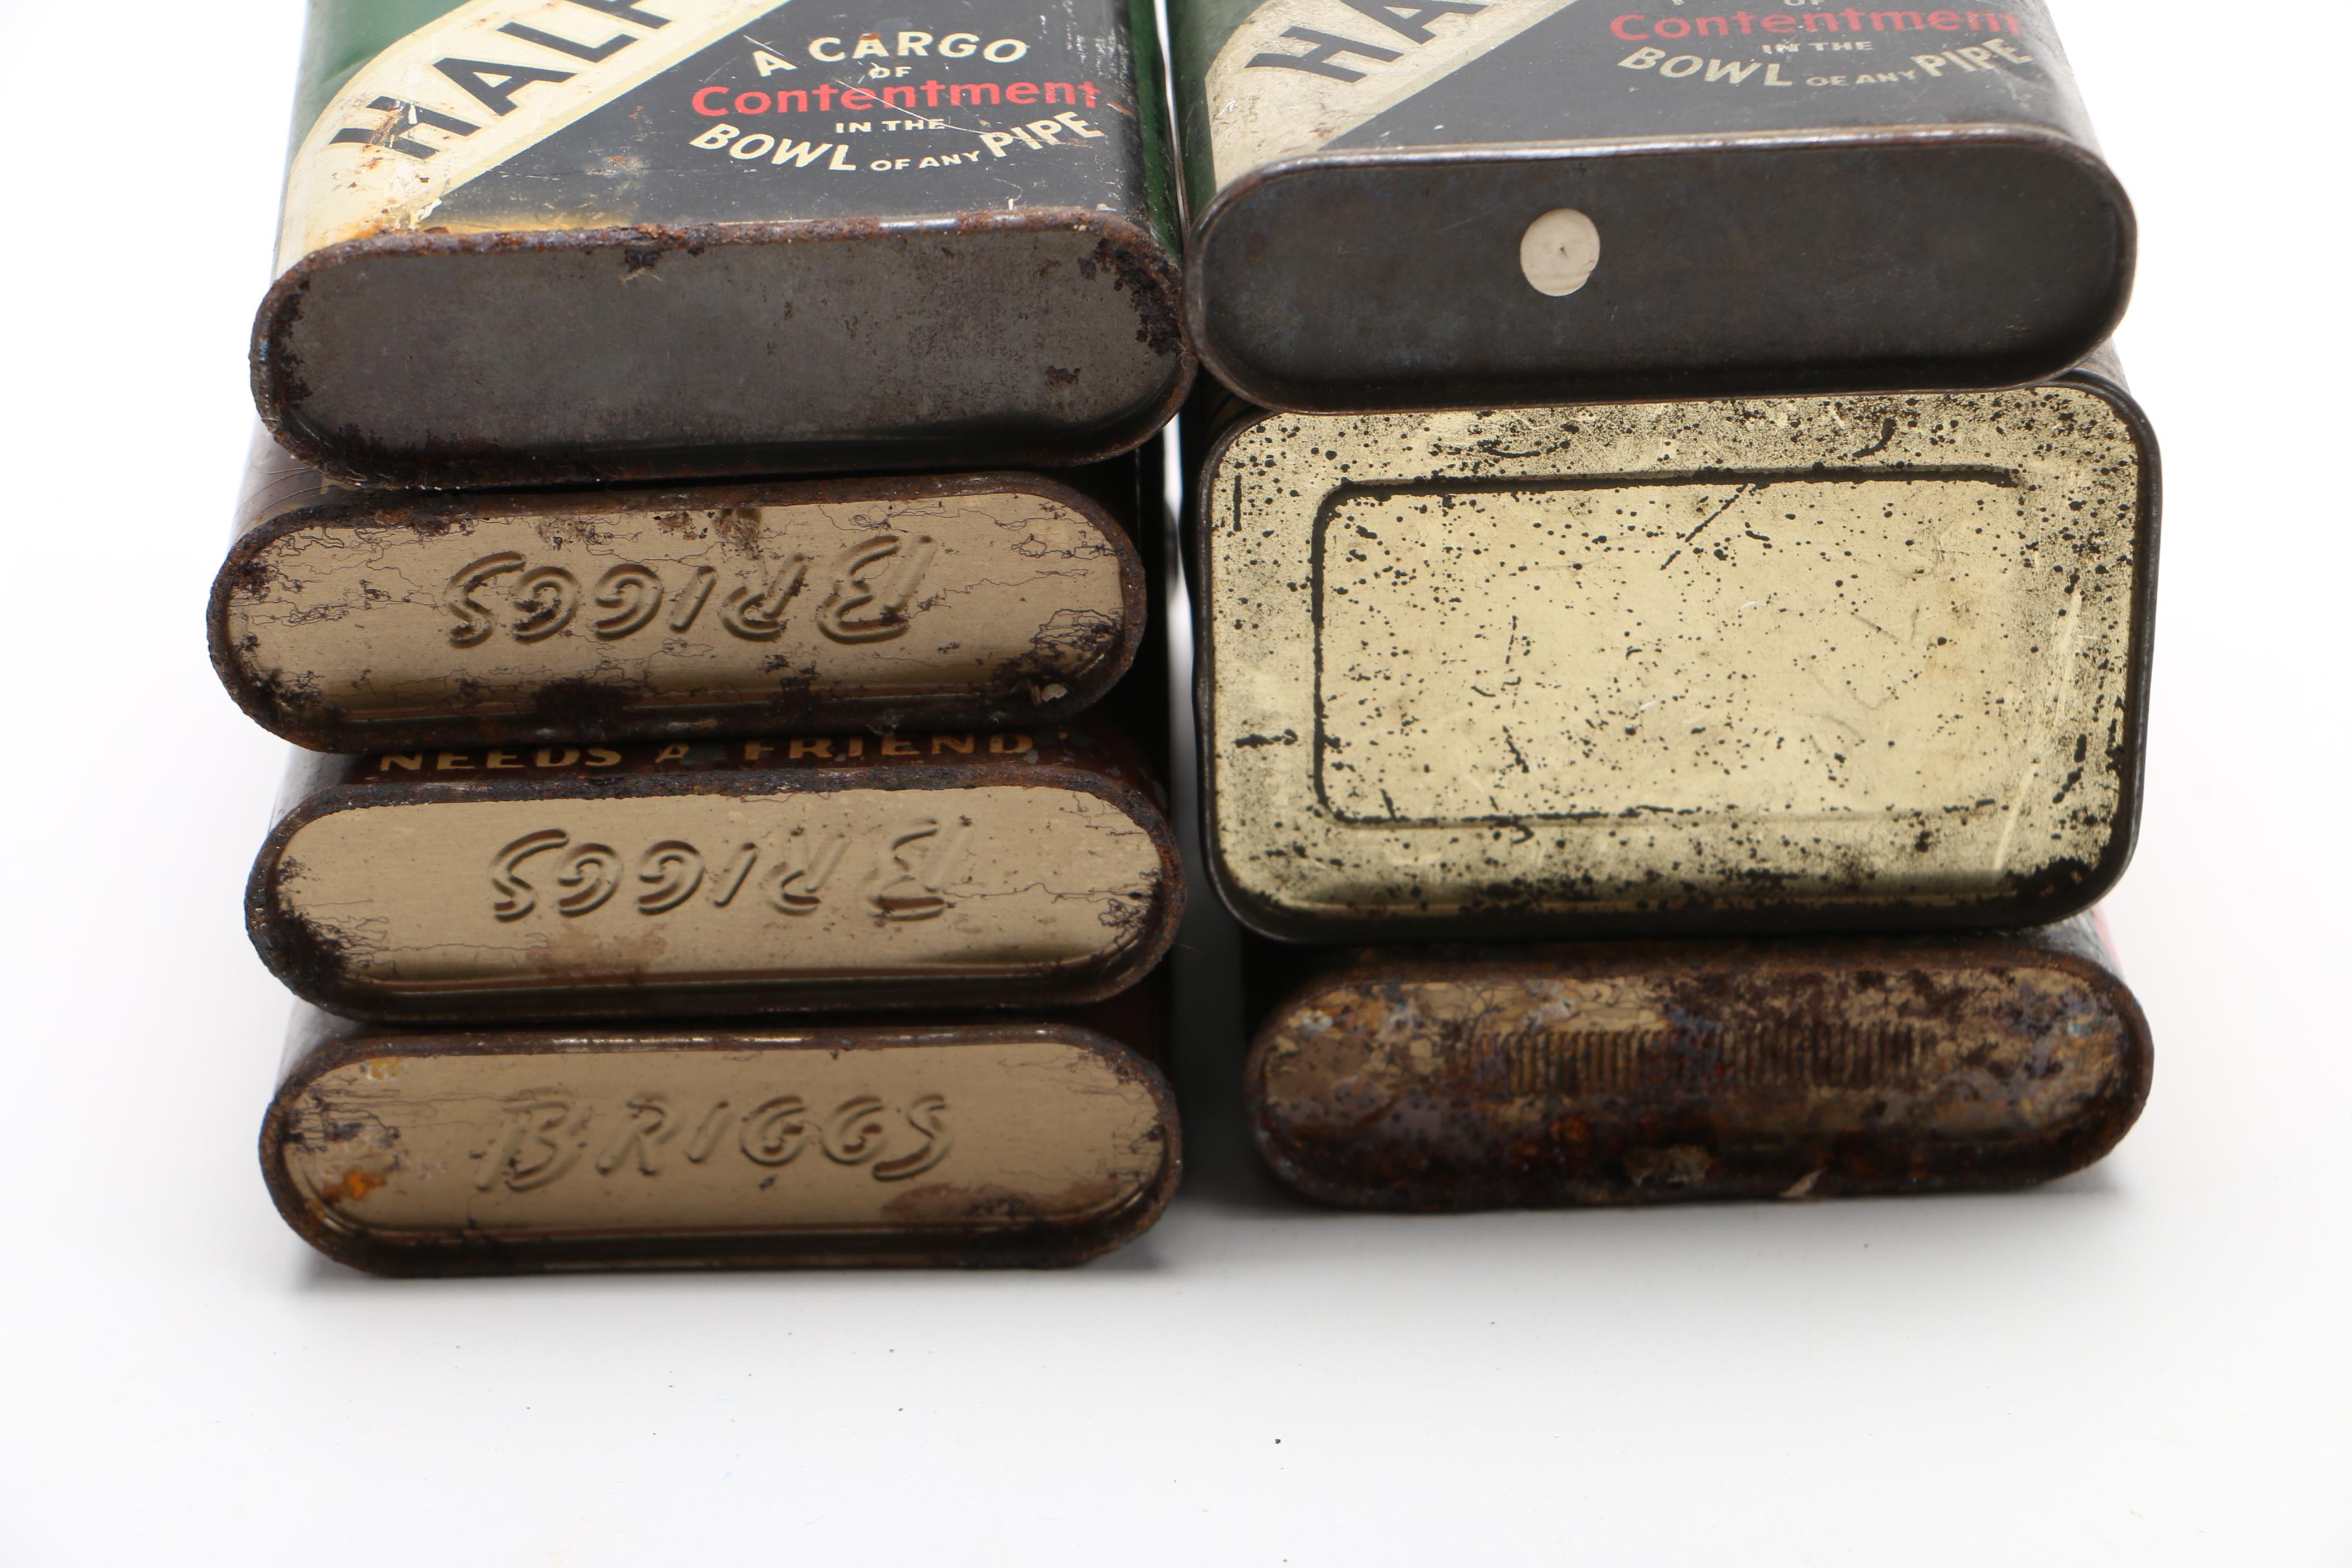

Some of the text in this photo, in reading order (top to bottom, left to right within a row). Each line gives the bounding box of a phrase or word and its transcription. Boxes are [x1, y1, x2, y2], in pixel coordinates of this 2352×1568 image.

[753, 31, 1028, 77] A CARGO
[1617, 37, 2034, 87] BOWL OF ANY PIPE
[1762, 41, 1873, 54] IN THE
[868, 66, 912, 79] OF
[692, 79, 1101, 117] Contentment
[689, 111, 1104, 172] BOWL OF ANY PIPE
[836, 119, 945, 133] IN THE
[445, 534, 936, 650] BRIGGS
[380, 732, 1034, 771] NEEDS A FRIEND
[490, 818, 976, 922] BRIGGS
[474, 1091, 953, 1191] BRIGGS
